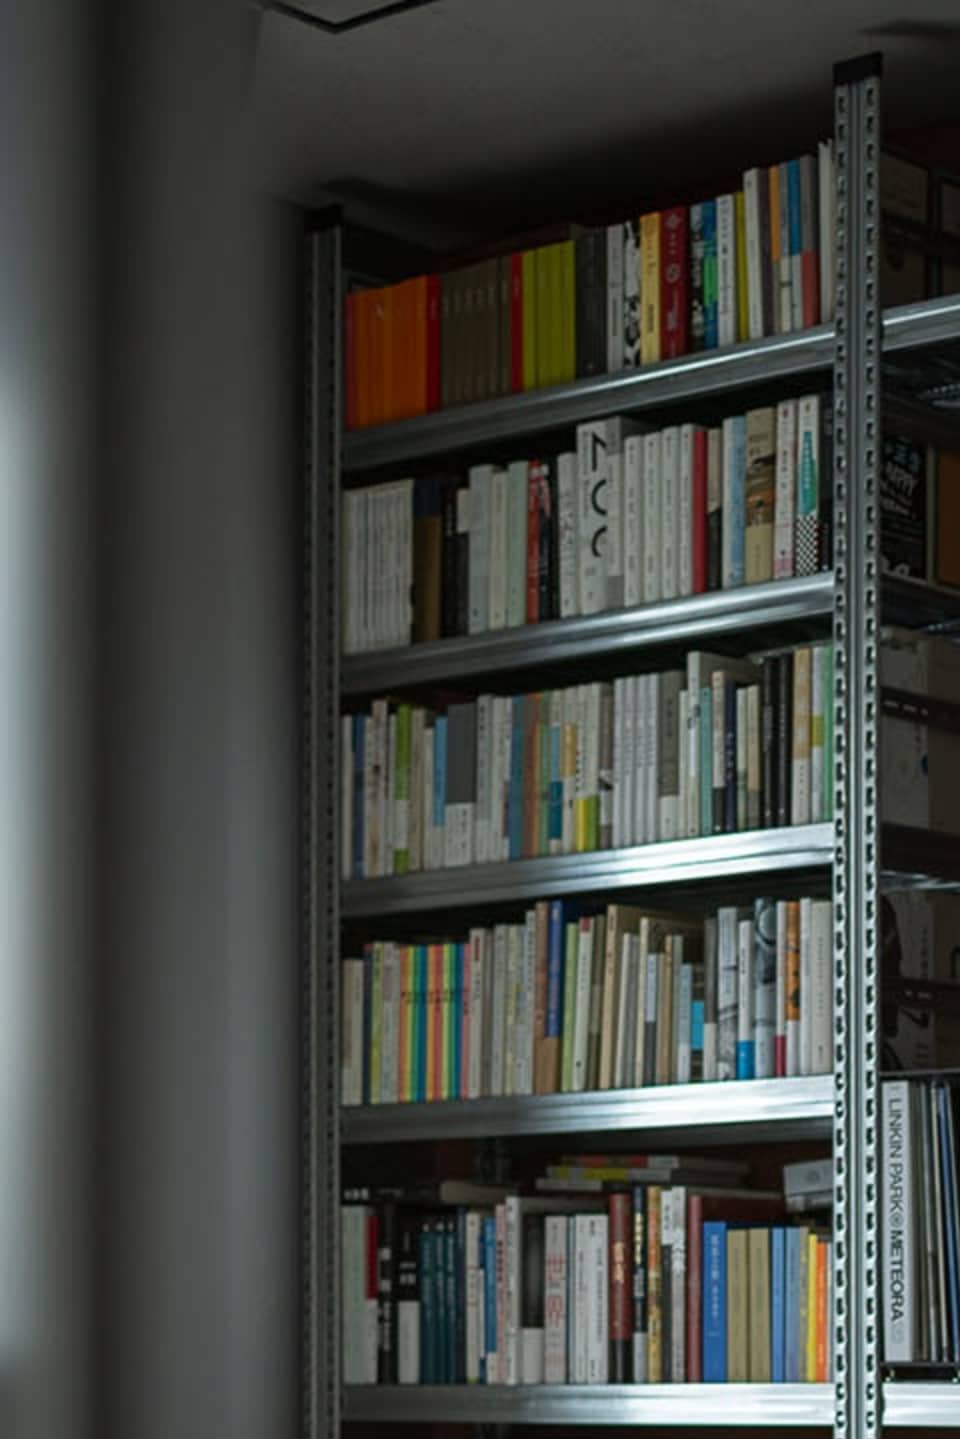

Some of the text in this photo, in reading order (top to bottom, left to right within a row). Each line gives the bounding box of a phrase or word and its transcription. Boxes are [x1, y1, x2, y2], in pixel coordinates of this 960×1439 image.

[887, 1098, 905, 1322] LINKIN PARK METEORA
